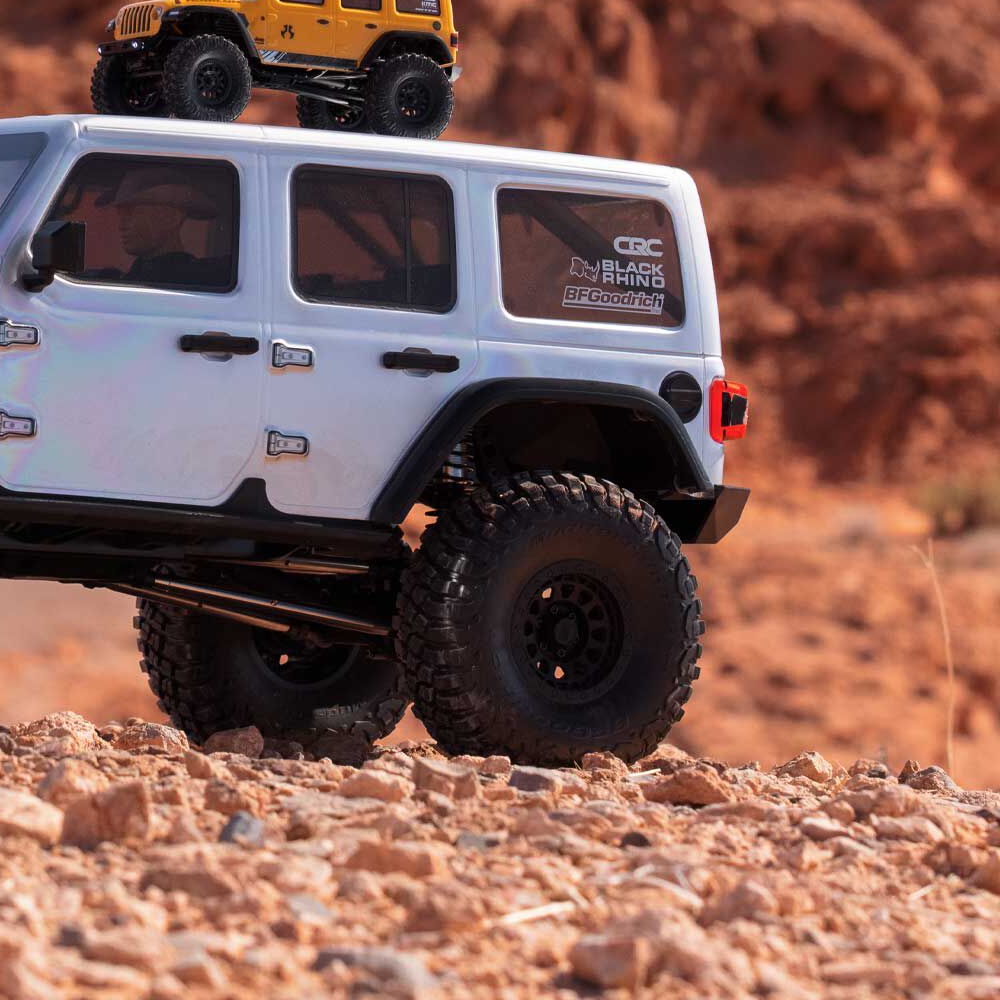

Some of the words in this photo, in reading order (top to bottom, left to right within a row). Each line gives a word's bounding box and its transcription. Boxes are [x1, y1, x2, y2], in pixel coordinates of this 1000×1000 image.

[613, 236, 664, 257] CRC
[602, 259, 664, 276] BLACK
[602, 272, 665, 288] RHINO
[564, 286, 664, 308] BFGoodrich
